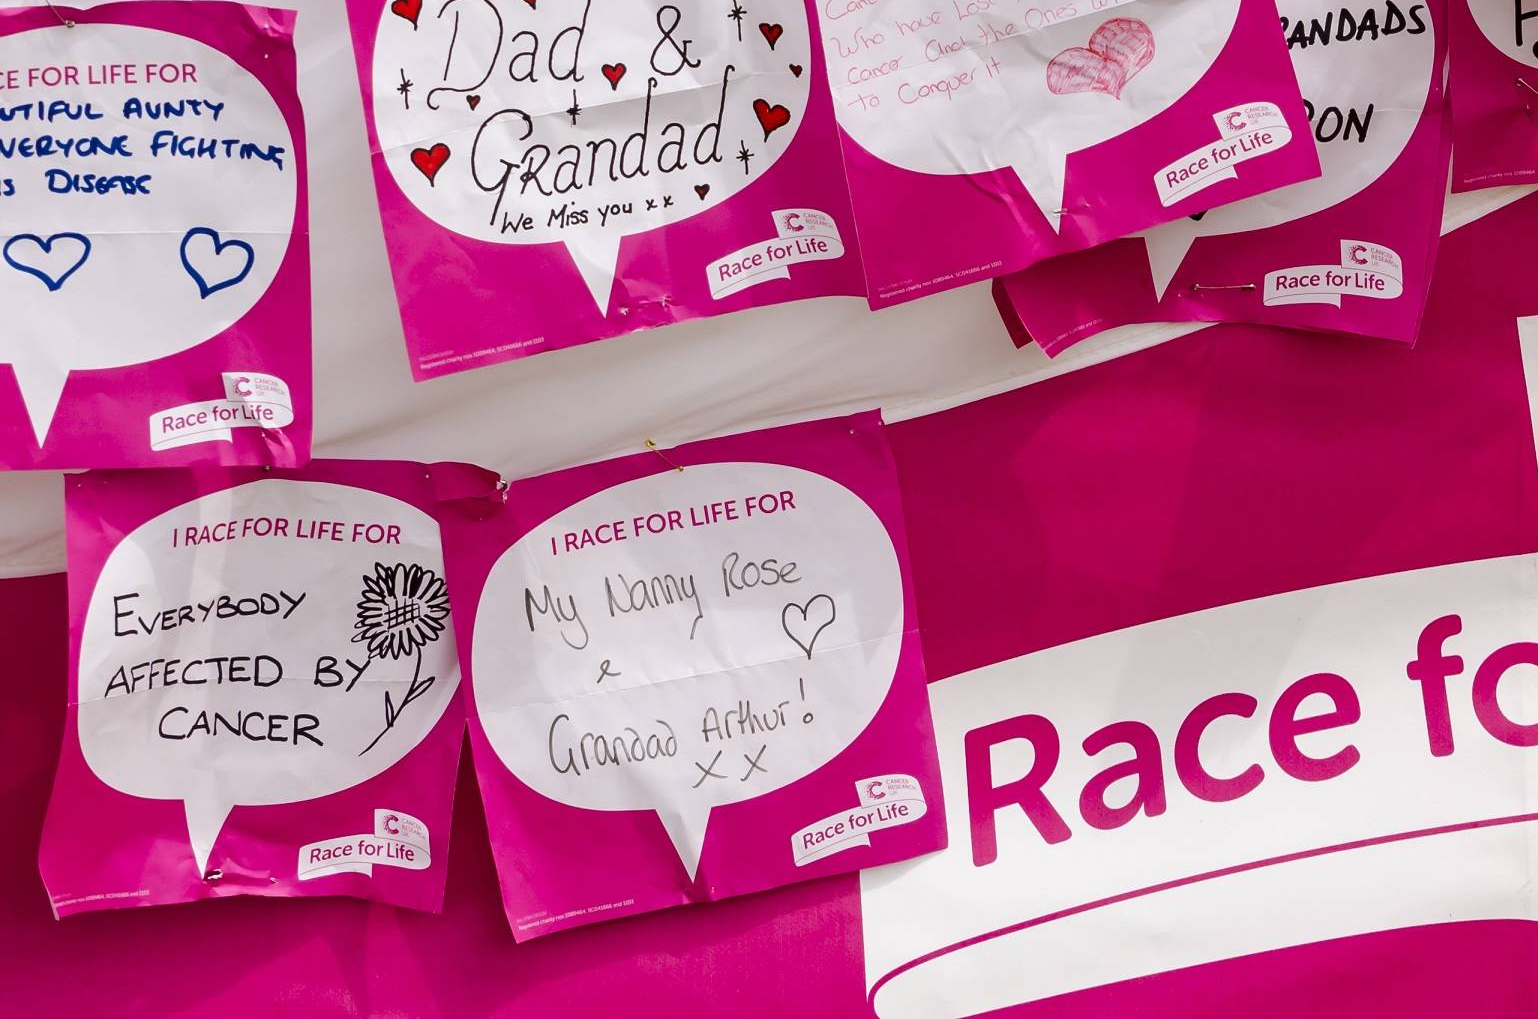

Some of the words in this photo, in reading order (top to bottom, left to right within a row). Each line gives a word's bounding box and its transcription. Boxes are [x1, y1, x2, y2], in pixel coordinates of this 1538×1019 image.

[648, 4, 702, 76] &
[28, 66, 80, 88] FOR
[88, 64, 137, 86] LIFE
[145, 63, 198, 85] FOR
[499, 207, 535, 235] We
[547, 201, 589, 229] Miss
[599, 197, 634, 227] you
[185, 520, 237, 547] RACE
[242, 516, 290, 538] FOR
[296, 521, 345, 541] LIFE
[351, 523, 401, 545] FOR
[565, 521, 628, 553] RACE
[633, 509, 685, 538] FOR
[689, 500, 740, 528] LIFE
[746, 489, 797, 517] FOR
[113, 590, 307, 638] EVERYBODY
[523, 583, 590, 650] My
[604, 573, 704, 641] Nanny
[720, 551, 803, 598] Rose
[104, 655, 284, 699] AFFECTED
[313, 655, 372, 693] BY
[158, 706, 325, 748] CANCER
[547, 713, 679, 777] Grandad
[963, 671, 1363, 868] Race
